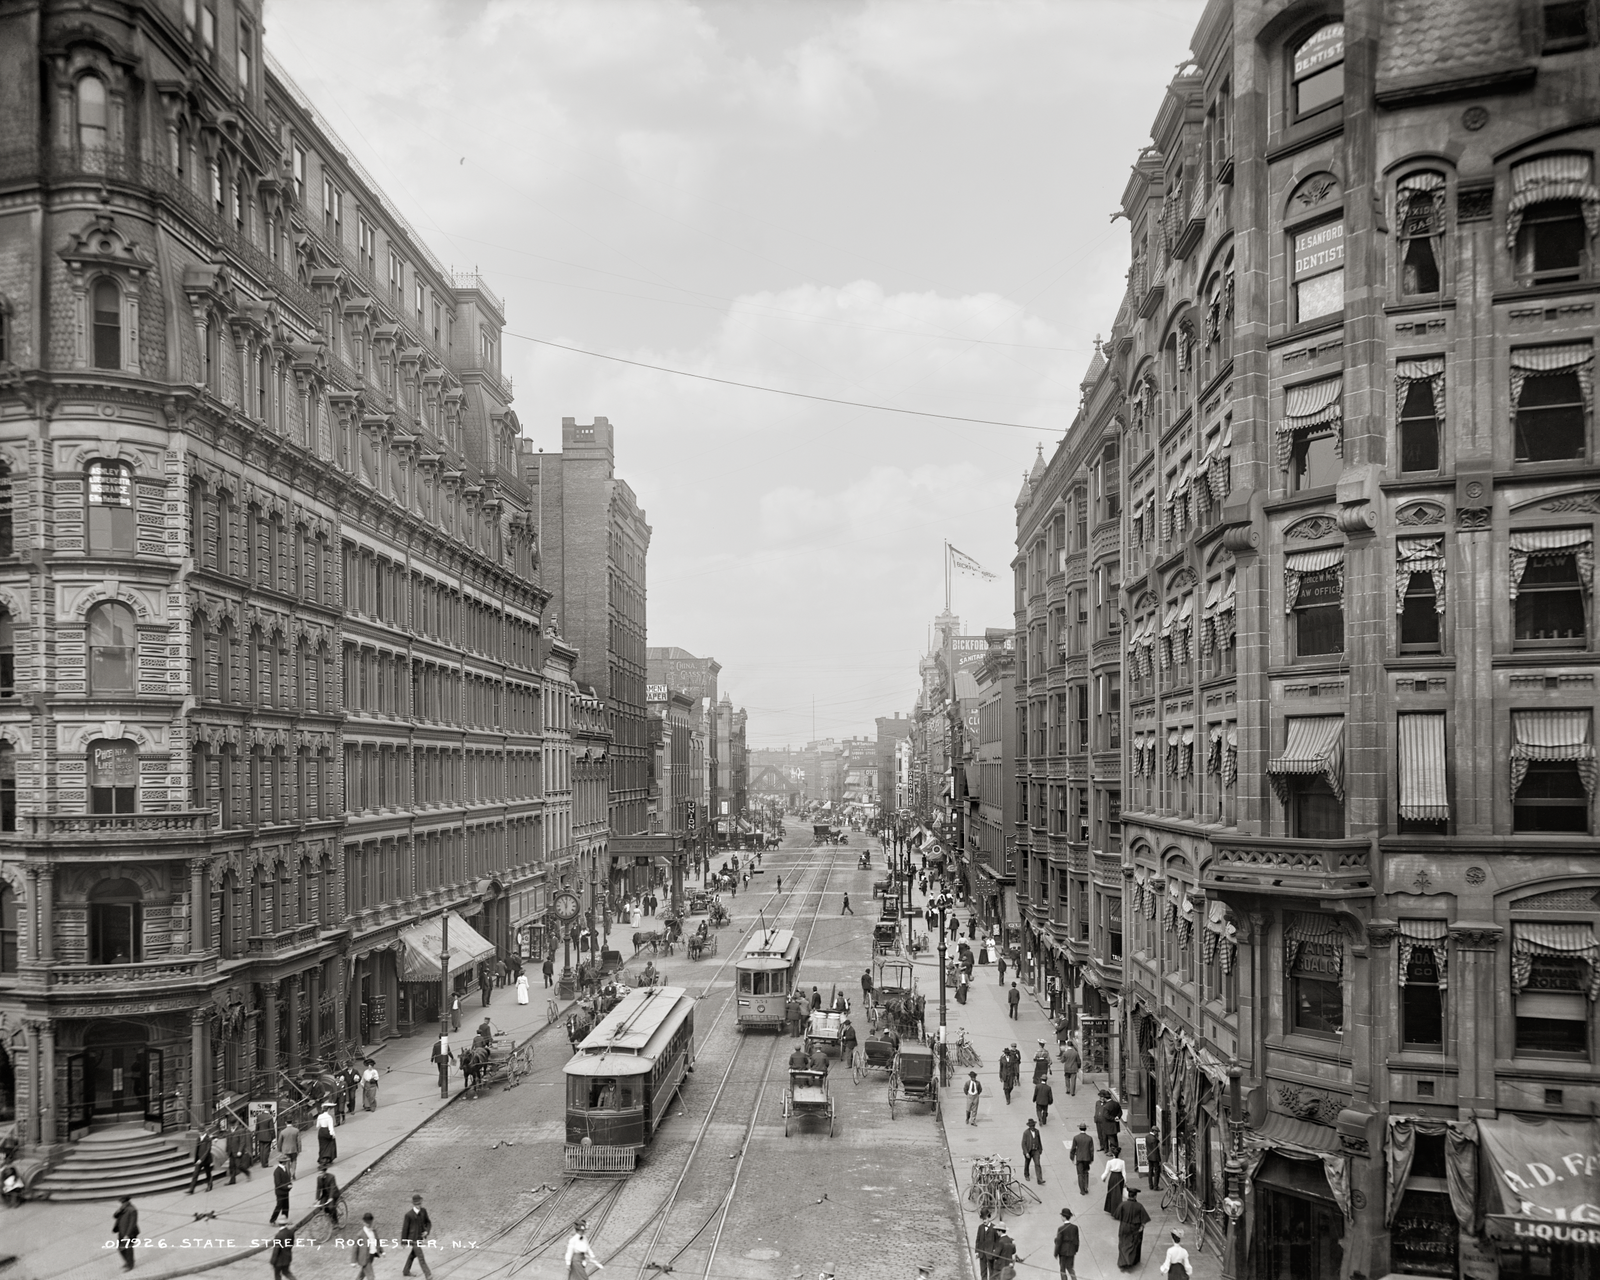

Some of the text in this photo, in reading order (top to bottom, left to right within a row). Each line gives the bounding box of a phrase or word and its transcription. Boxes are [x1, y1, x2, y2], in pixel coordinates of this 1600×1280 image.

[1307, 225, 1343, 248] SANFORD
[1295, 245, 1344, 273] DENTIST.
[1533, 557, 1567, 568] LAW
[687, 802, 695, 830] UNION
[118, 1004, 151, 1014] TRUST
